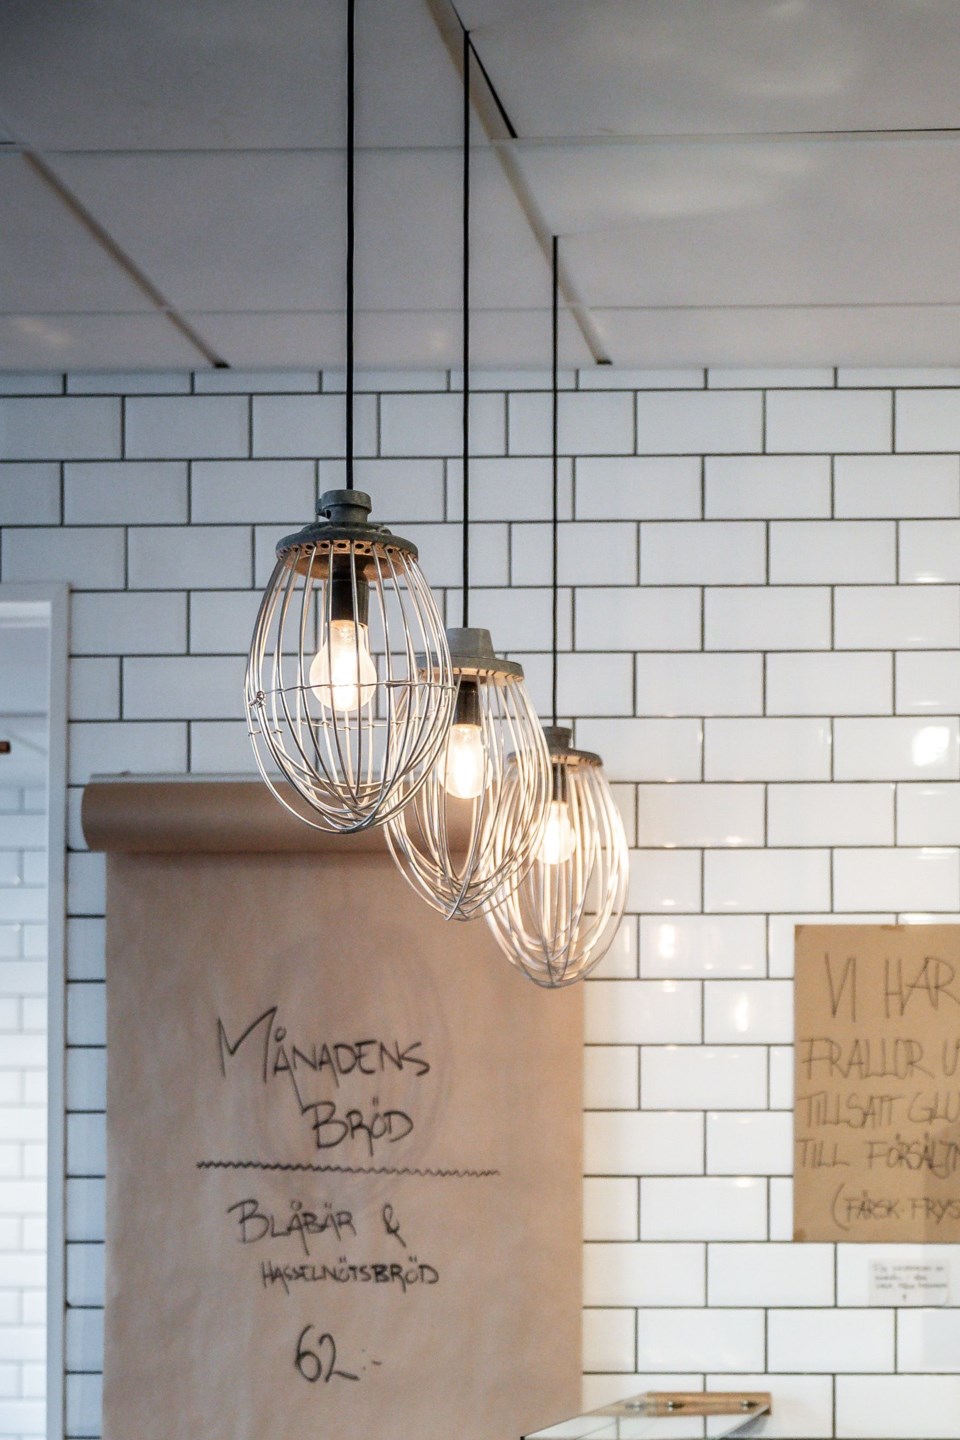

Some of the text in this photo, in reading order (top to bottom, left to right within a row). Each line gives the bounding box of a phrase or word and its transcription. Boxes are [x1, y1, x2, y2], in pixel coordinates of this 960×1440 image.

[824, 951, 857, 1023] VI
[216, 1004, 431, 1090] MÅNADENS
[301, 1096, 414, 1157] BRÖD
[798, 1089, 903, 1130] TILLSATT
[796, 1137, 850, 1170] TILL
[227, 1198, 406, 1257] BLÅBÄR &
[260, 1255, 440, 1296] HASSELNÖTSBRÖD
